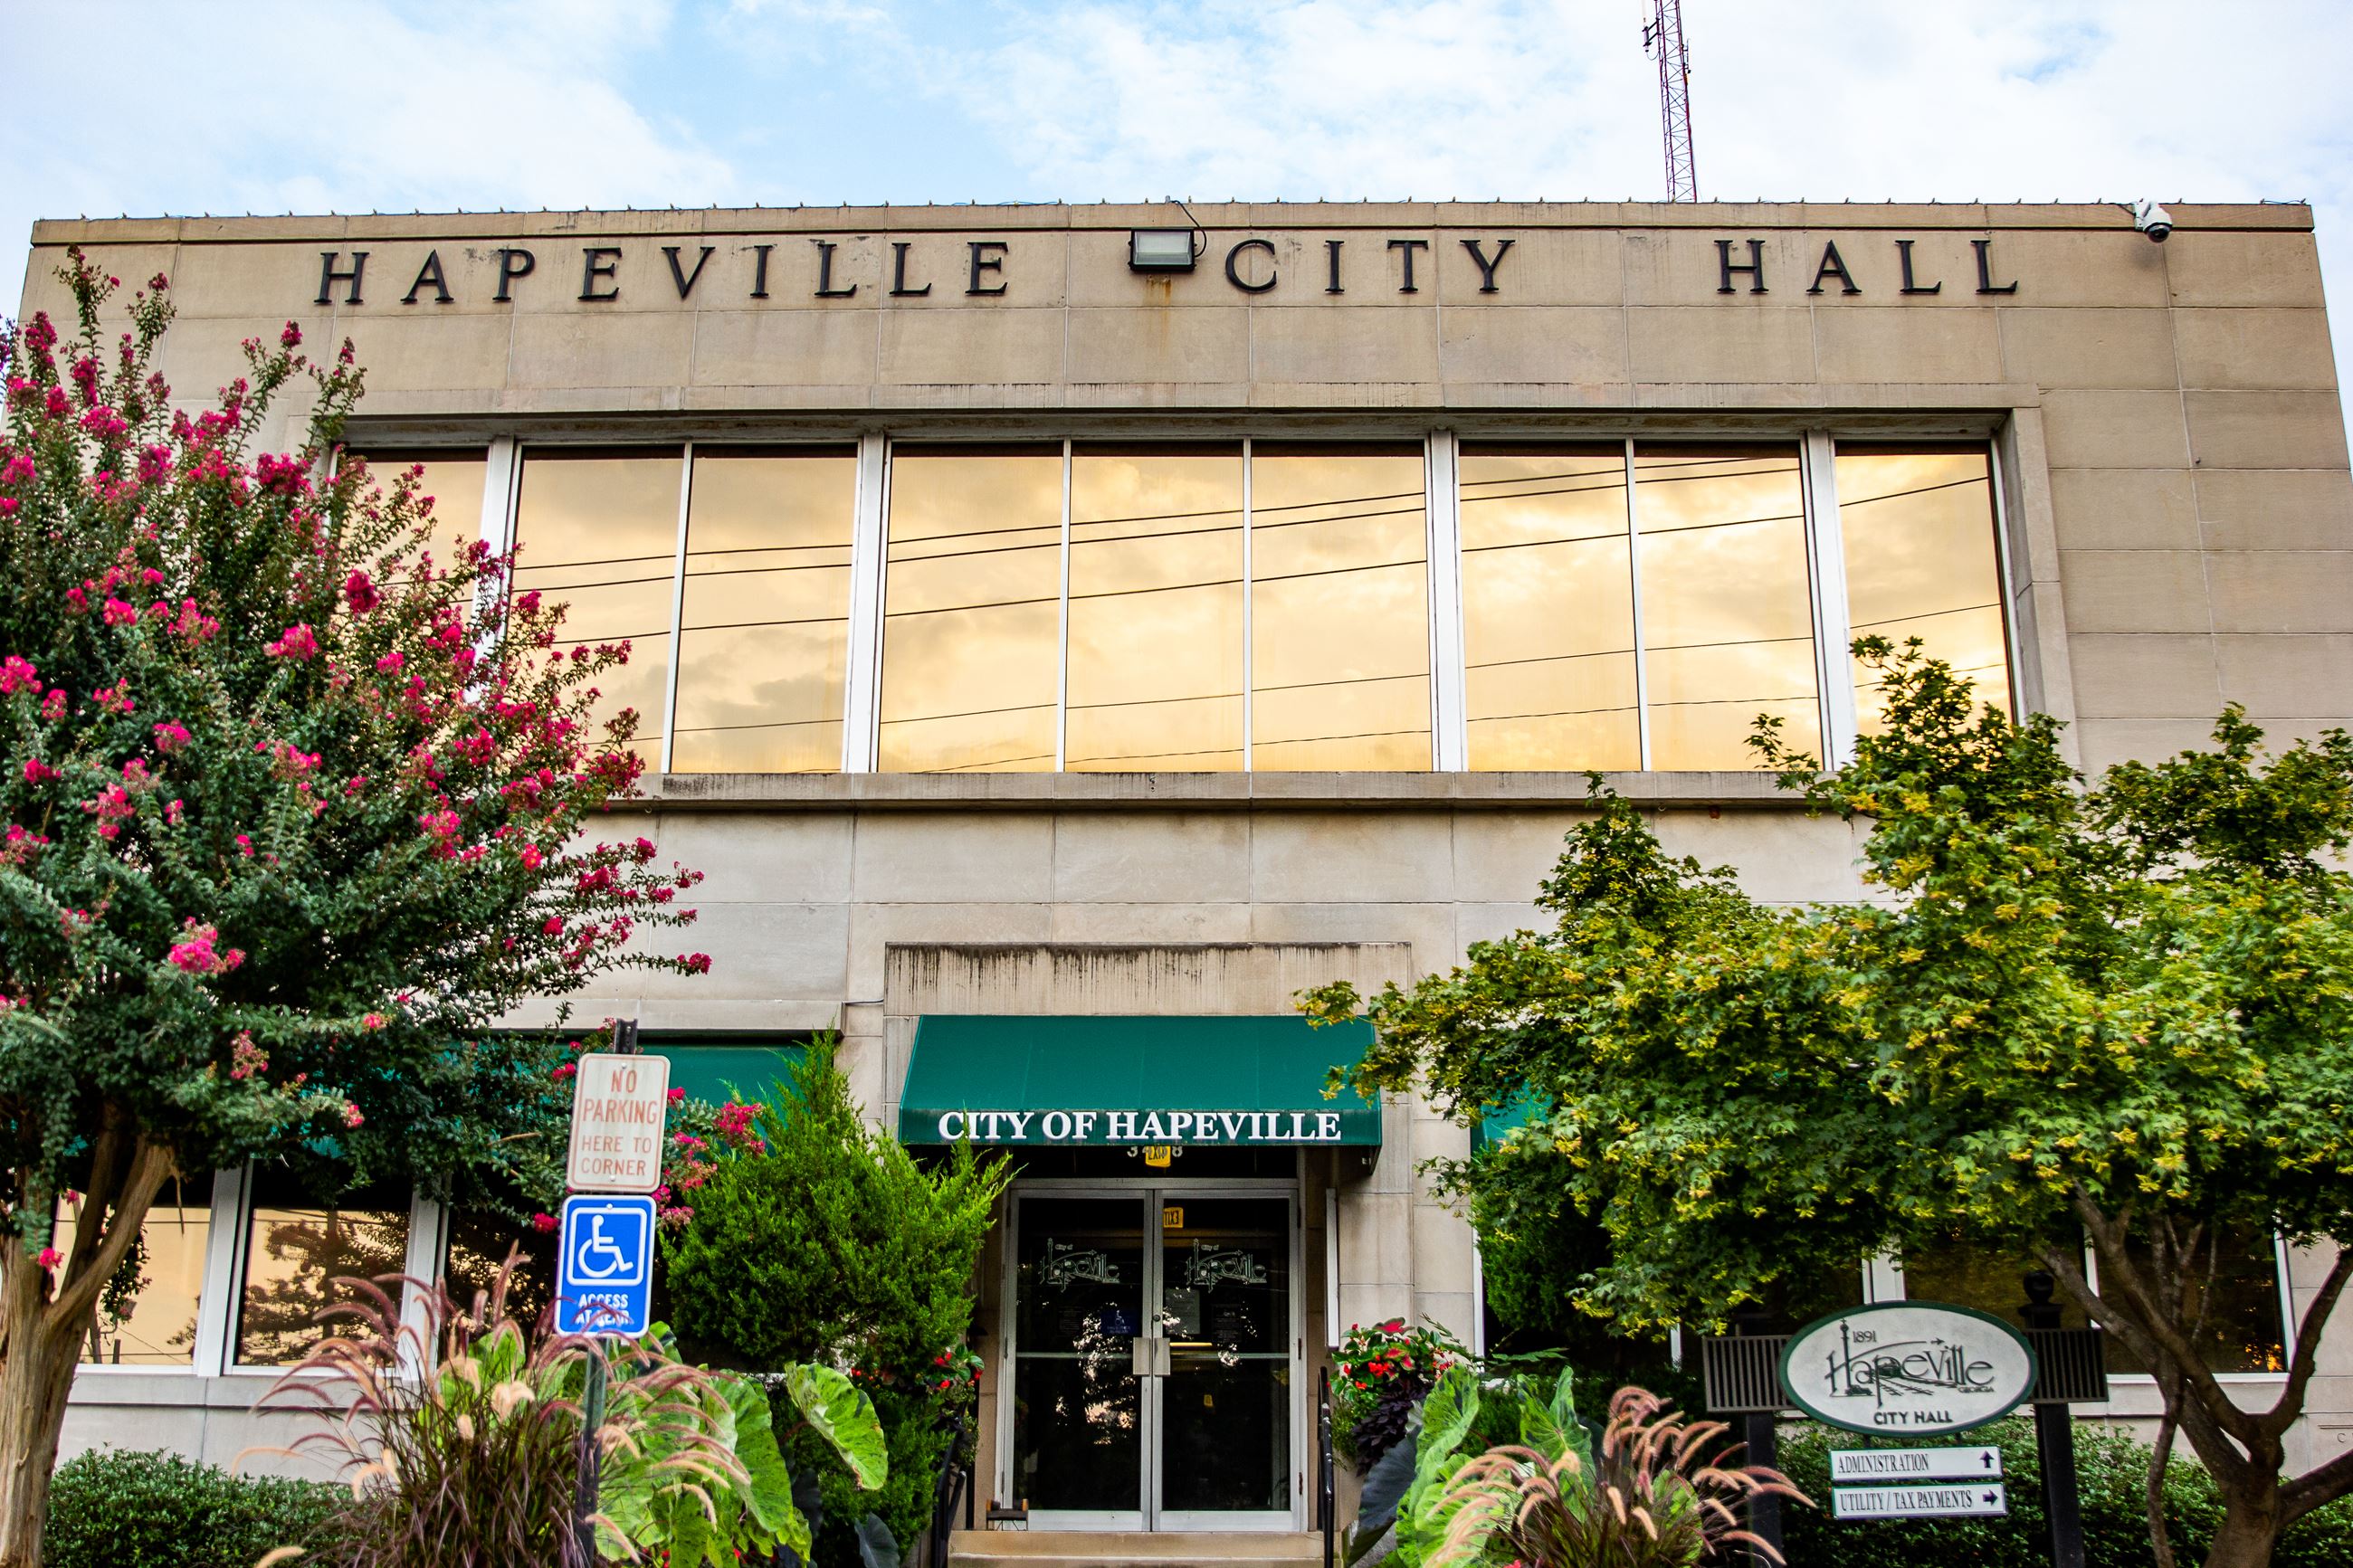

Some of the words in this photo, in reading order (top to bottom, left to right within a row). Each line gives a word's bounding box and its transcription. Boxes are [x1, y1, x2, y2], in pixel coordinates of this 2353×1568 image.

[313, 241, 1009, 305] HAPEVILLE
[1224, 239, 1516, 295] CITY
[1713, 240, 2018, 296] HALL
[611, 1069, 637, 1093] NO
[583, 1098, 658, 1125] PARKING
[938, 1111, 1034, 1140] CITY
[1042, 1111, 1097, 1140] OF
[1106, 1111, 1341, 1140] HAPEVILLE
[582, 1136, 624, 1153] HERE
[634, 1137, 652, 1154] TO
[581, 1157, 646, 1176] CORNER
[578, 1293, 629, 1309] ACCESS
[1853, 1331, 1878, 1344] 1891
[1873, 1411, 1909, 1425] CITY
[1914, 1410, 1953, 1424] HALL
[1838, 1453, 1929, 1474] ADMINISTRATION
[1840, 1492, 1884, 1512] UTILITY
[1894, 1491, 1916, 1510] TAX
[1918, 1489, 1973, 1509] PAYMENTS
